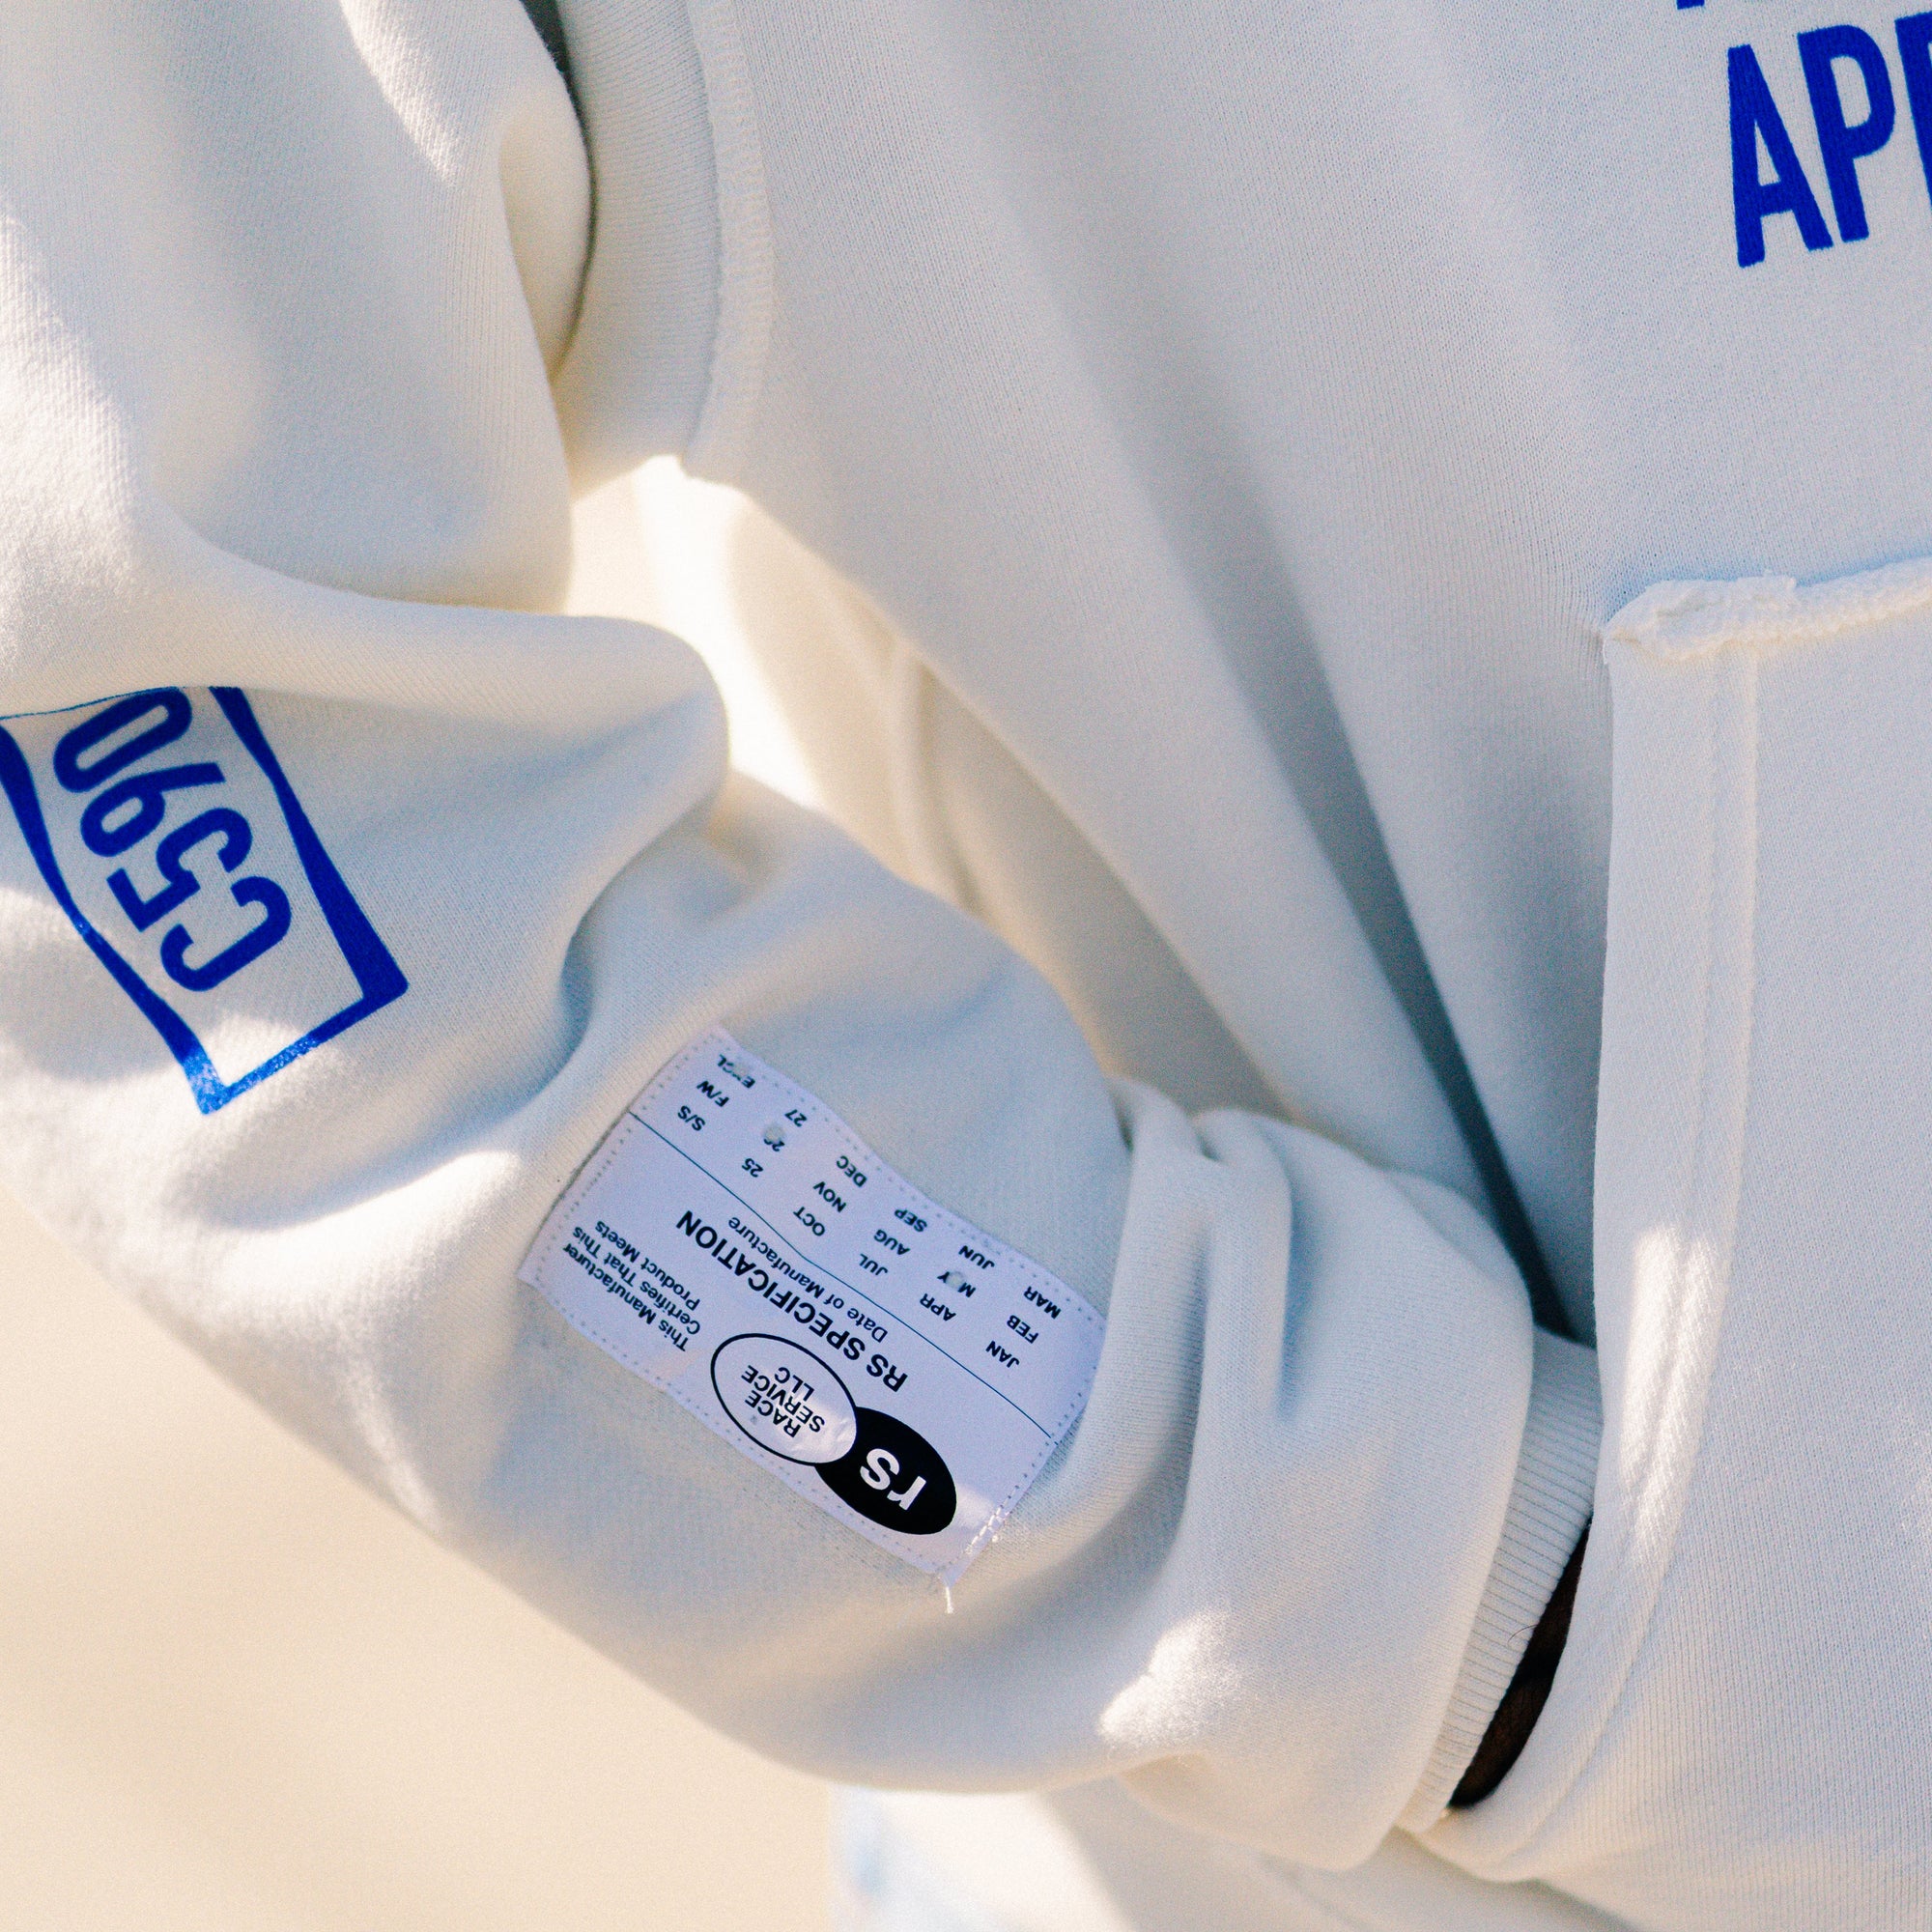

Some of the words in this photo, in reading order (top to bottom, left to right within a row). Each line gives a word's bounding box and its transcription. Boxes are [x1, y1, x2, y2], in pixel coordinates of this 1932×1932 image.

[53, 686, 292, 992] C590
[696, 1080, 730, 1108] F/W
[677, 1105, 706, 1132] S/S
[783, 1109, 808, 1127] 27
[741, 1157, 764, 1179] 25
[836, 1154, 867, 1188] DEC
[812, 1180, 847, 1213] NOV
[792, 1206, 826, 1237] OCT
[894, 1208, 928, 1233] SEP
[572, 1226, 602, 1260] This
[594, 1220, 640, 1264] Meets
[727, 1216, 825, 1299] Manufacture
[873, 1229, 911, 1256] AUG
[958, 1244, 995, 1270] JUN
[603, 1252, 637, 1288] That
[859, 1253, 889, 1276] JUL
[562, 1242, 657, 1325] Manufacturer
[640, 1257, 701, 1312] Product
[675, 1209, 866, 1361] SPECIFICATION
[936, 1270, 977, 1298] MY
[639, 1281, 701, 1335] Certifies
[823, 1293, 845, 1310] of
[919, 1293, 957, 1321] APR
[1023, 1286, 1062, 1320] MAR
[658, 1319, 689, 1352] This
[846, 1307, 889, 1344] Date
[1006, 1314, 1039, 1345] FEB
[985, 1340, 1020, 1369] JAN
[774, 1366, 815, 1402] LLC
[866, 1353, 909, 1393] RS
[740, 1364, 826, 1433] SERVICE
[744, 1389, 802, 1438] RACE
[860, 1448, 927, 1511] rs
